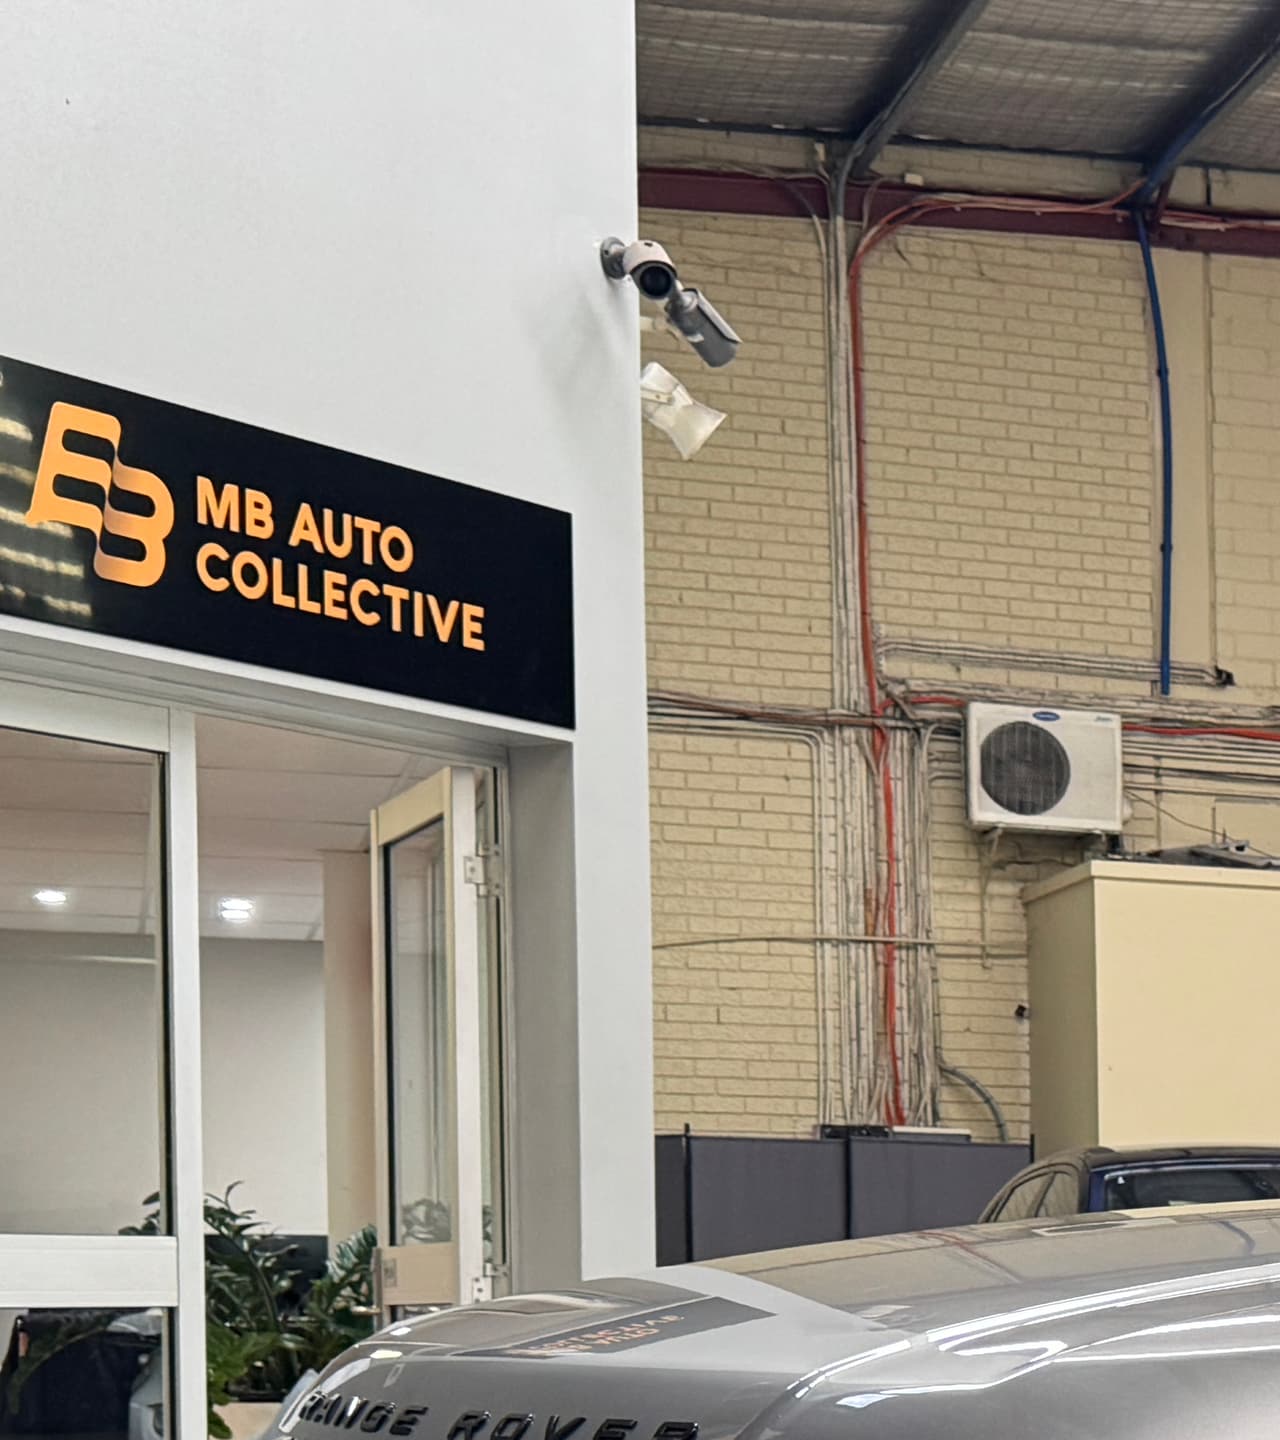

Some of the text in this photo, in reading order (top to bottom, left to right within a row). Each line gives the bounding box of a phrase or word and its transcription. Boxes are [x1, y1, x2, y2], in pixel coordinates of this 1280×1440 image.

[195, 476, 415, 574] MB AUTO
[195, 542, 486, 652] COLLECTIVE
[299, 1391, 429, 1436] RANGE
